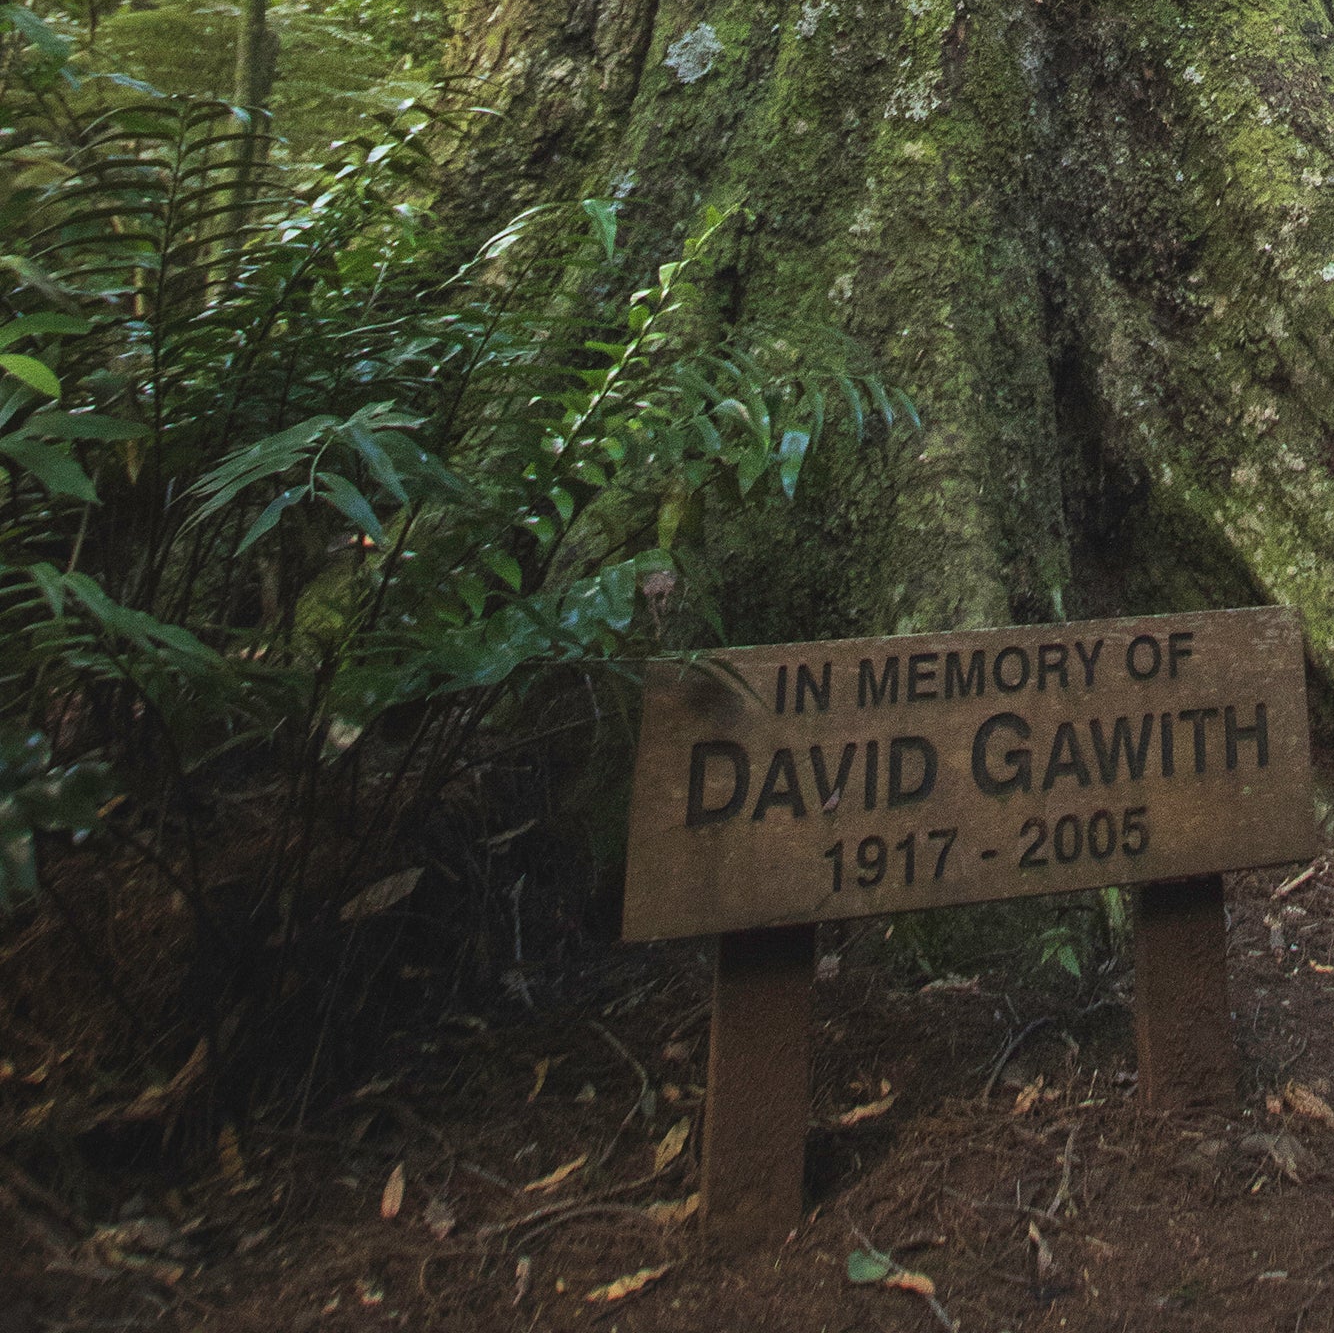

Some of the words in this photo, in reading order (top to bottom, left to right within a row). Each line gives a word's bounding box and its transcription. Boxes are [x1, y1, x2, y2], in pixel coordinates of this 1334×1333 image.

[776, 664, 833, 714] IN
[858, 639, 1104, 708] MEMORY
[1126, 633, 1195, 681] OF
[686, 736, 939, 829] DAVID
[971, 703, 1270, 796] GAWITH
[825, 827, 958, 892] 1917
[981, 850, 998, 860] -
[1019, 806, 1150, 869] 2005
